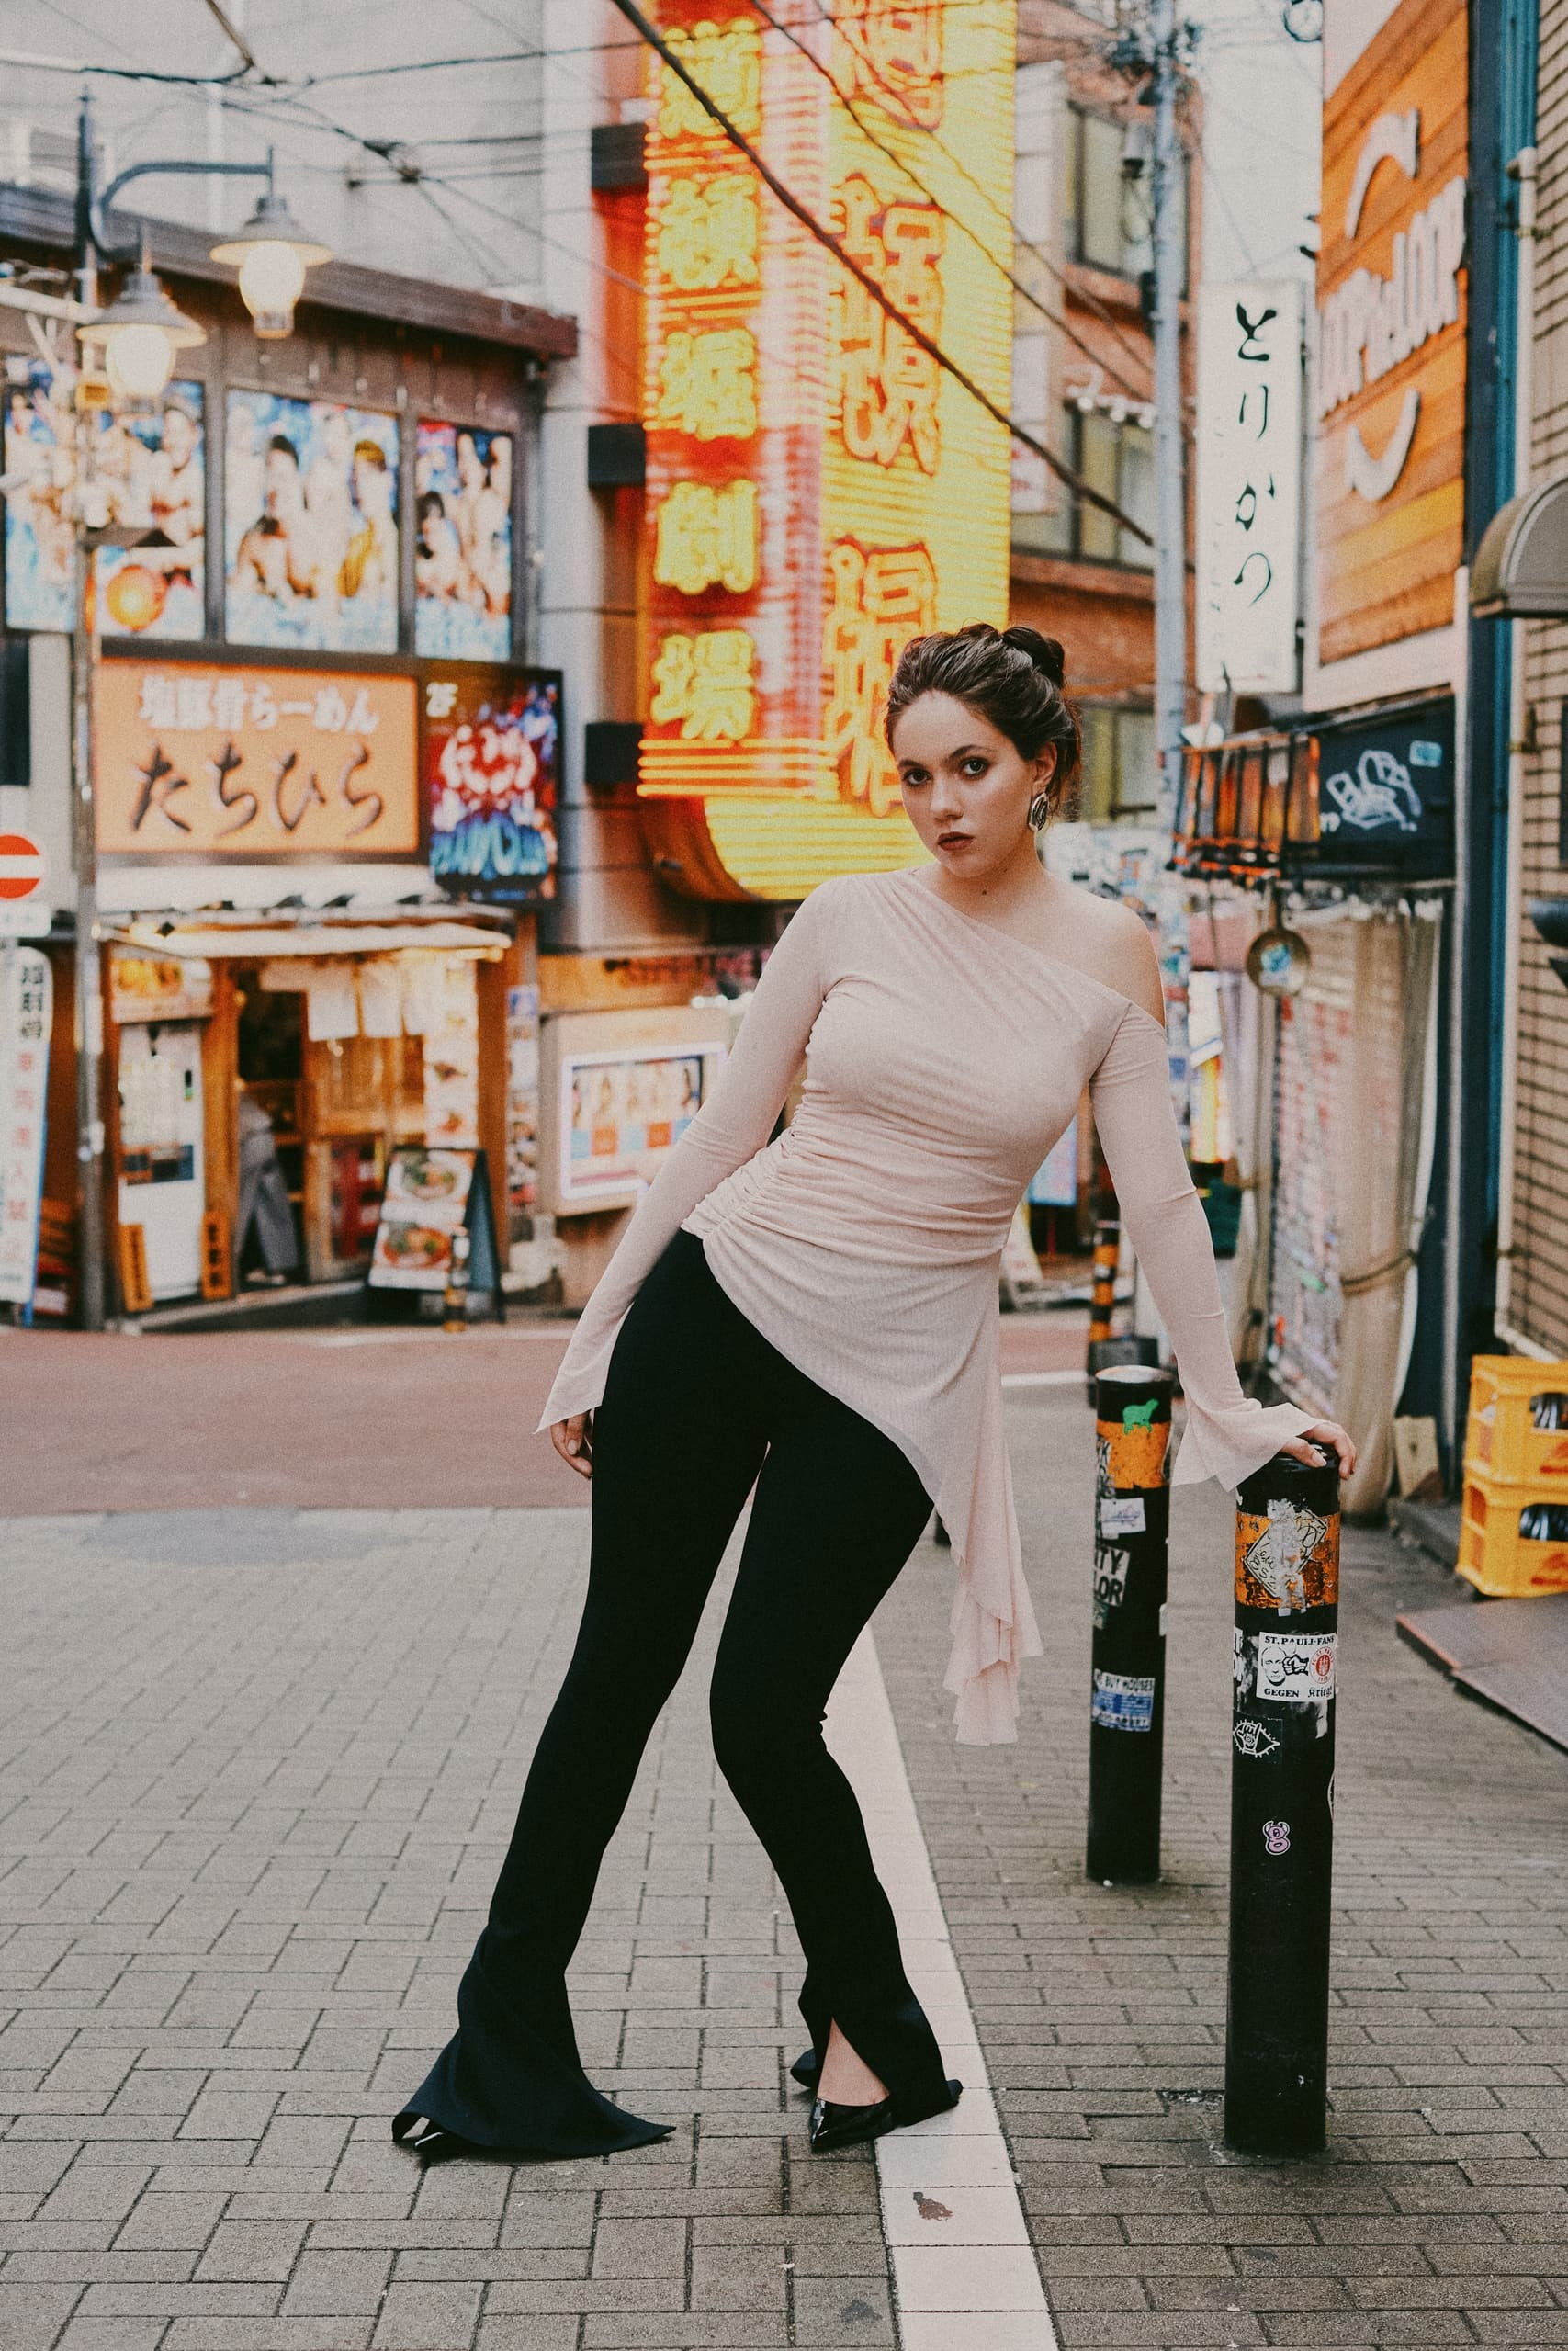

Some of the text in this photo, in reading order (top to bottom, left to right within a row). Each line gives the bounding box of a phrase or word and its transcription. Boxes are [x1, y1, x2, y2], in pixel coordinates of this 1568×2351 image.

[1234, 301, 1278, 606] とりかつ
[130, 738, 384, 838] たちひら
[1265, 1635, 1280, 1645] ST.
[1264, 1689, 1299, 1698] GEGEN
